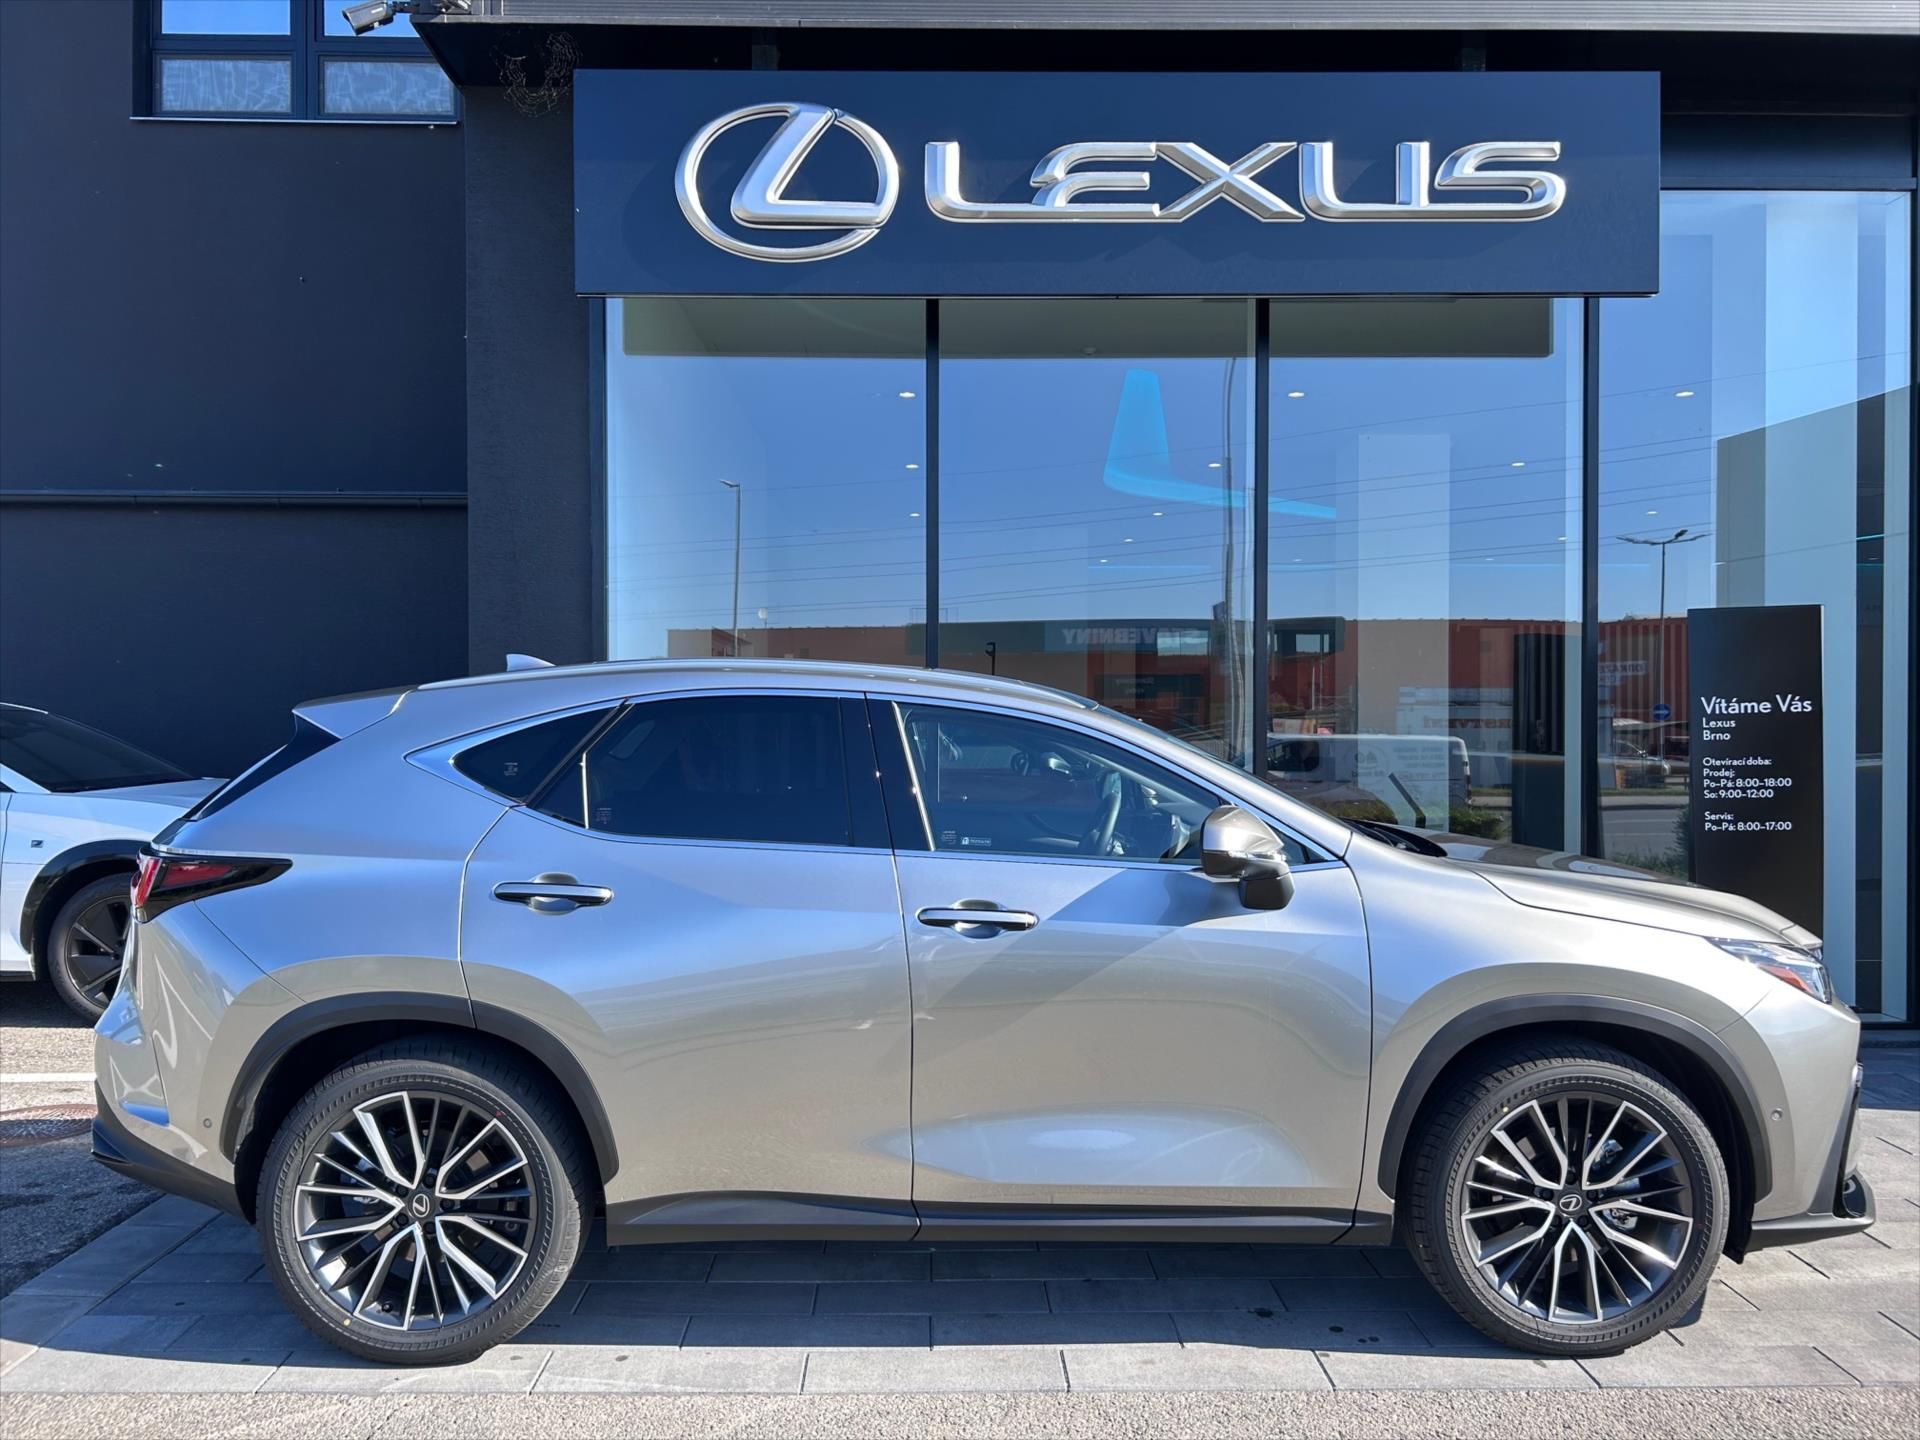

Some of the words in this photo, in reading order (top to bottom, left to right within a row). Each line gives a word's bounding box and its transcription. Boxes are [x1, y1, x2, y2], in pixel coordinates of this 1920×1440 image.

[924, 140, 1567, 223] LEXUS
[1700, 695, 1772, 715] Vítáme
[1775, 693, 1813, 713] Vás
[1702, 716, 1736, 728] Lexus
[1702, 729, 1732, 741] Brno
[1746, 756, 1772, 766] doba:
[1703, 768, 1736, 778] Prodej:
[1703, 789, 1718, 799] So:
[1704, 811, 1734, 821] Servis:
